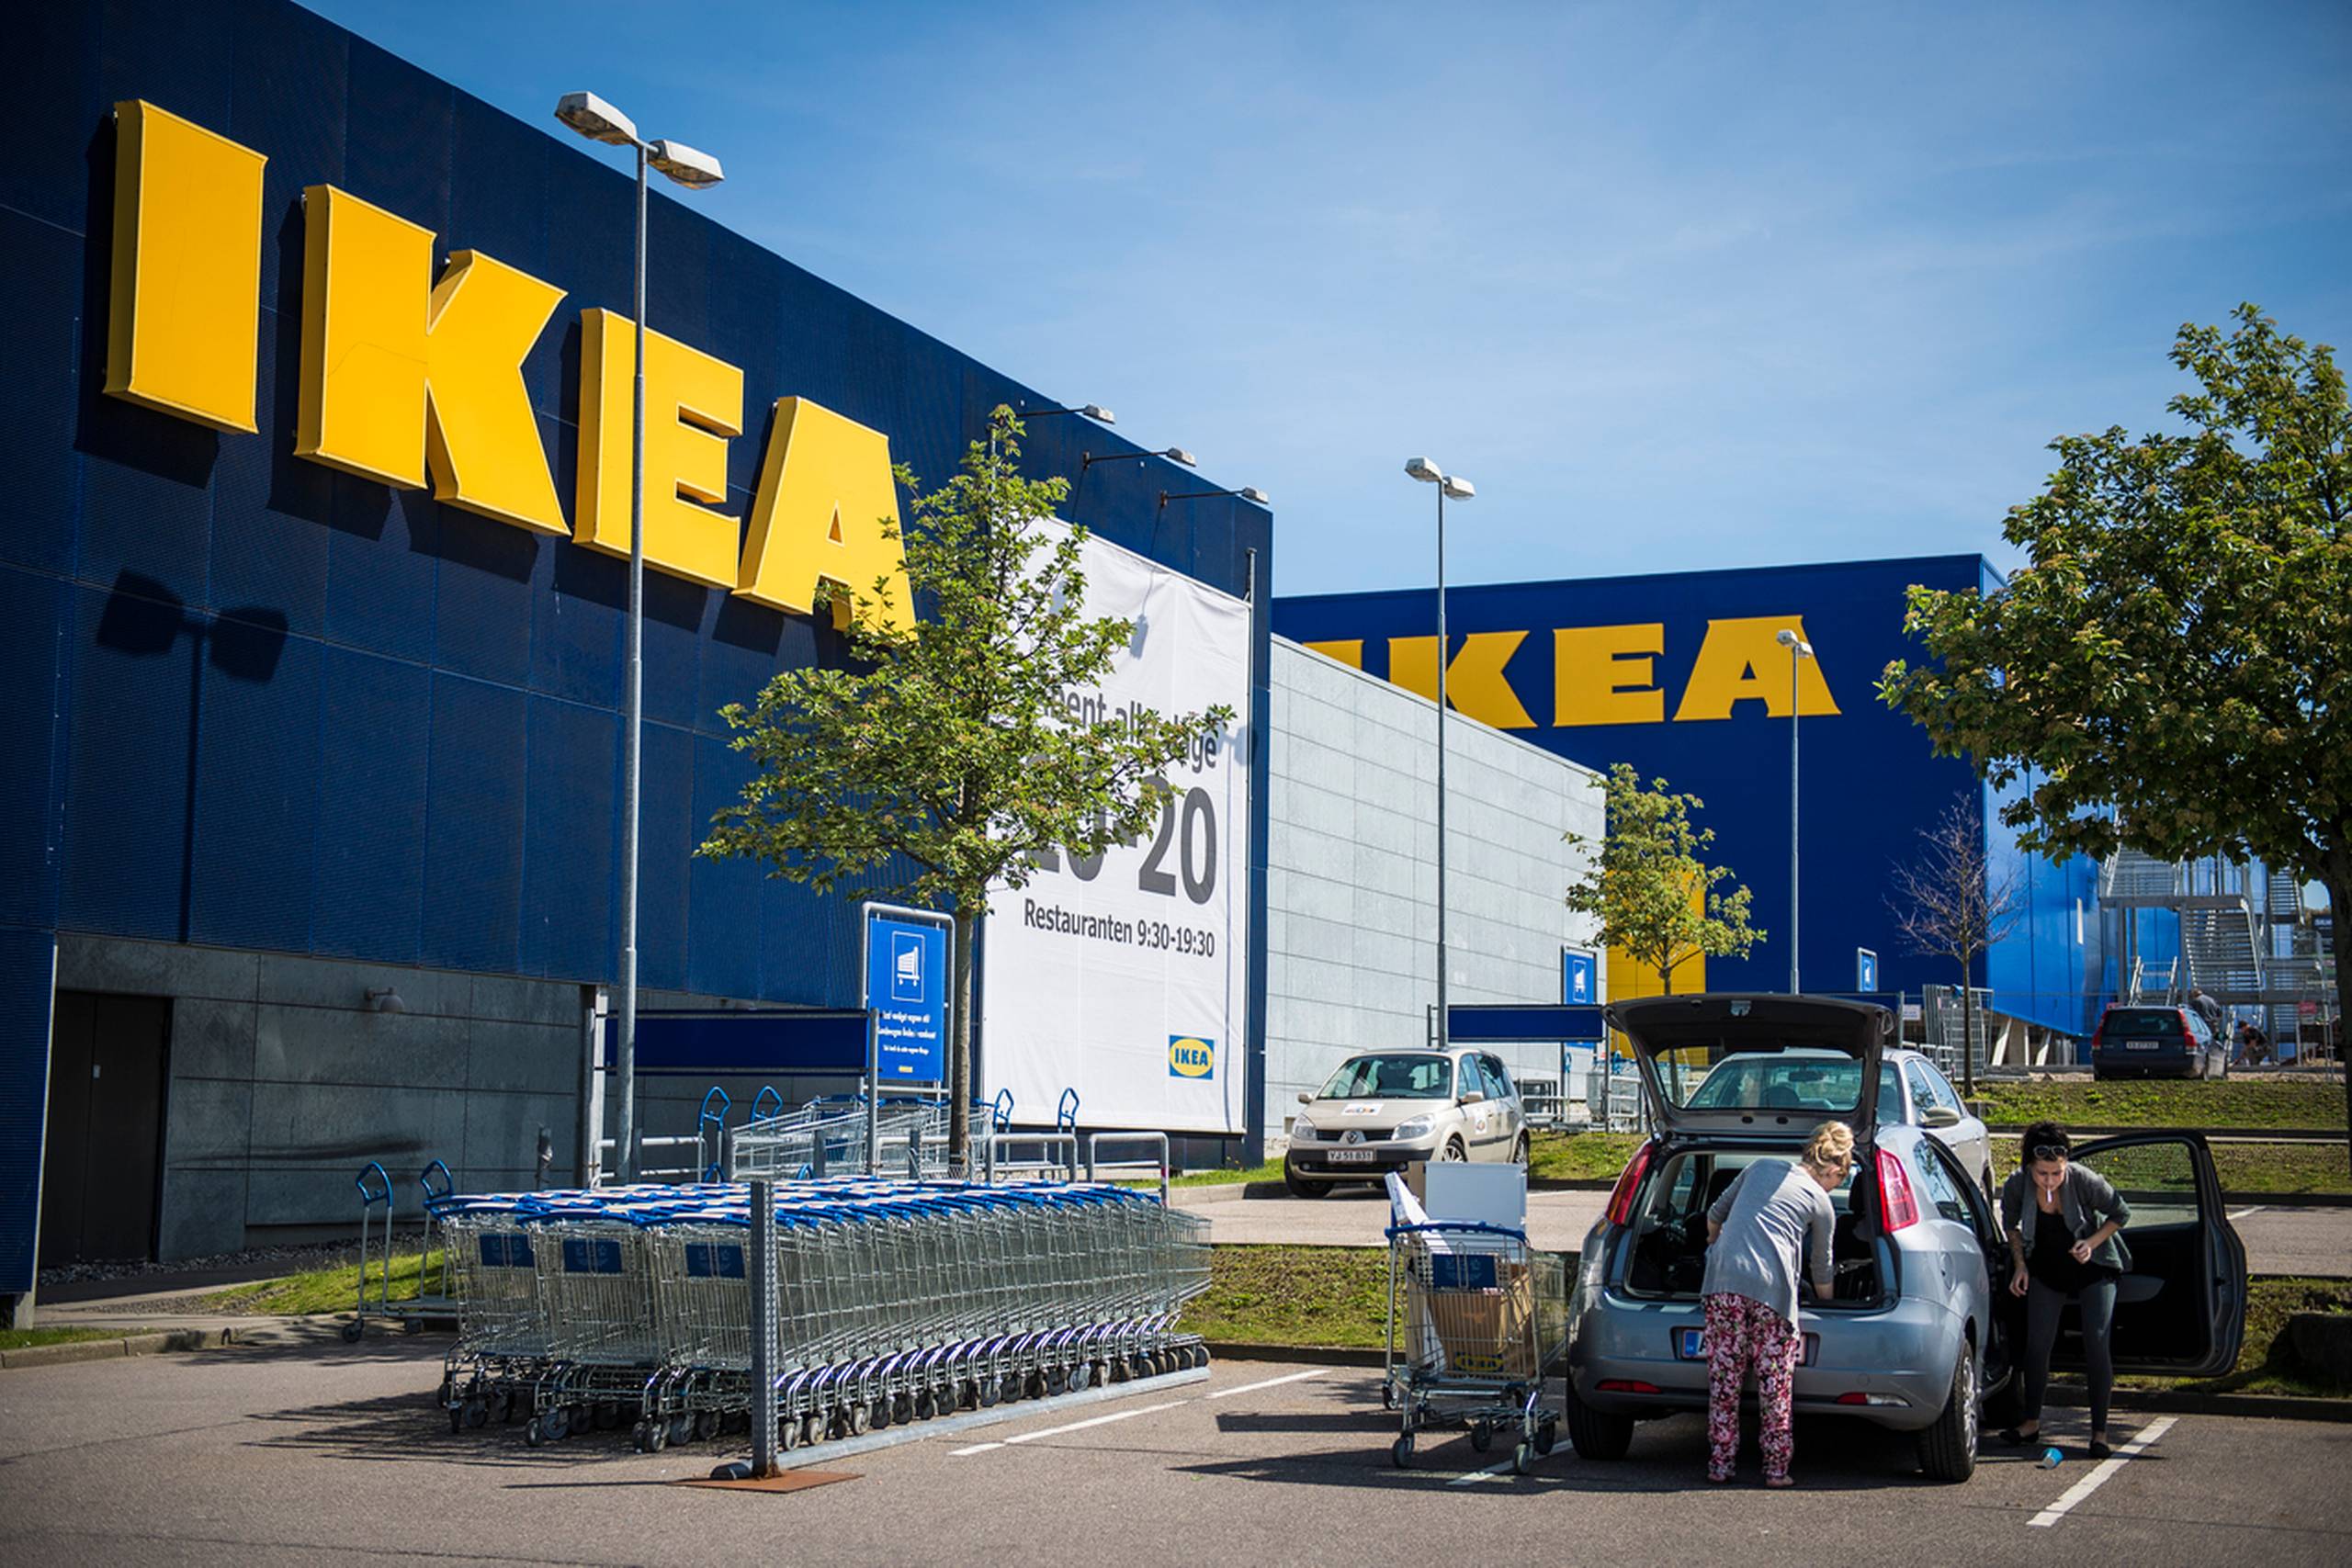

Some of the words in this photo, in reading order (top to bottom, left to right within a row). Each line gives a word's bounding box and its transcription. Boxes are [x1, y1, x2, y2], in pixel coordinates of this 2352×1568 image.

[104, 98, 919, 645] IKEA
[1303, 615, 1841, 728] KEA
[1025, 753, 1216, 905] -20
[1024, 898, 1132, 944] Restauranten
[1137, 919, 1216, 957] 9:30-19:30
[1175, 1047, 1208, 1066] IKEA
